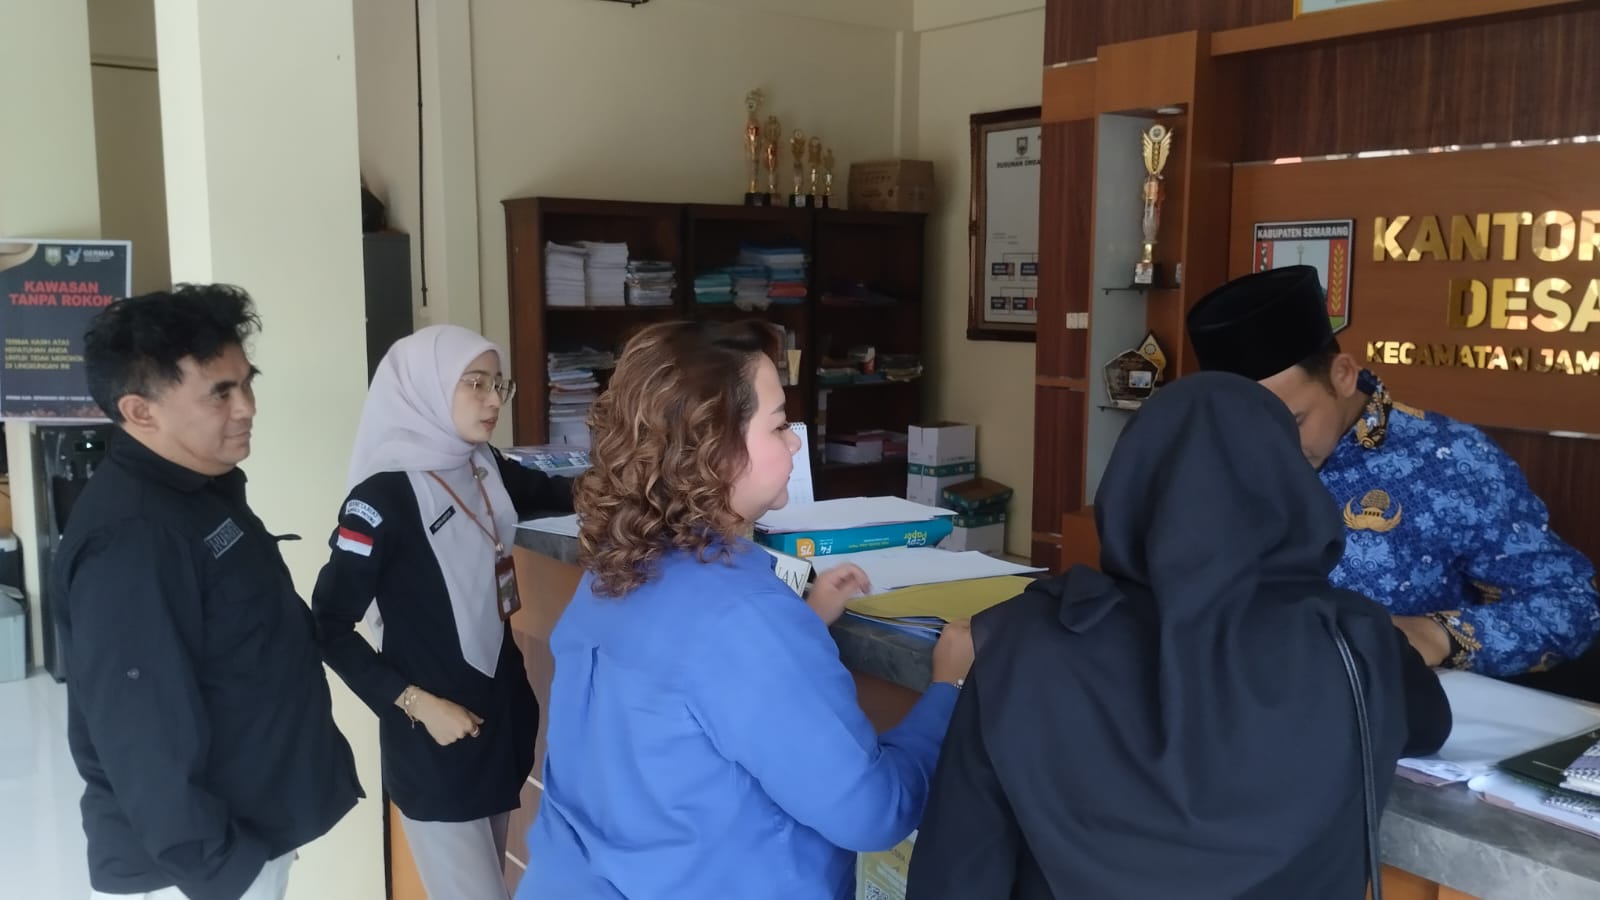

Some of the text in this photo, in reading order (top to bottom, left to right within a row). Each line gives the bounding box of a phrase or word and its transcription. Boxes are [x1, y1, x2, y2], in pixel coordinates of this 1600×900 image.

[1257, 226, 1349, 239] KABUPATEN SEMARANG
[1373, 210, 1600, 262] KANTOR
[23, 280, 99, 293] KAWASAN
[9, 293, 112, 307] TANPA ROKOK
[1448, 277, 1600, 332] DESA
[1366, 341, 1530, 371] KECAMATAN
[904, 530, 928, 540] Paper
[907, 538, 926, 547] Copy
[801, 545, 832, 556] 75 F4
